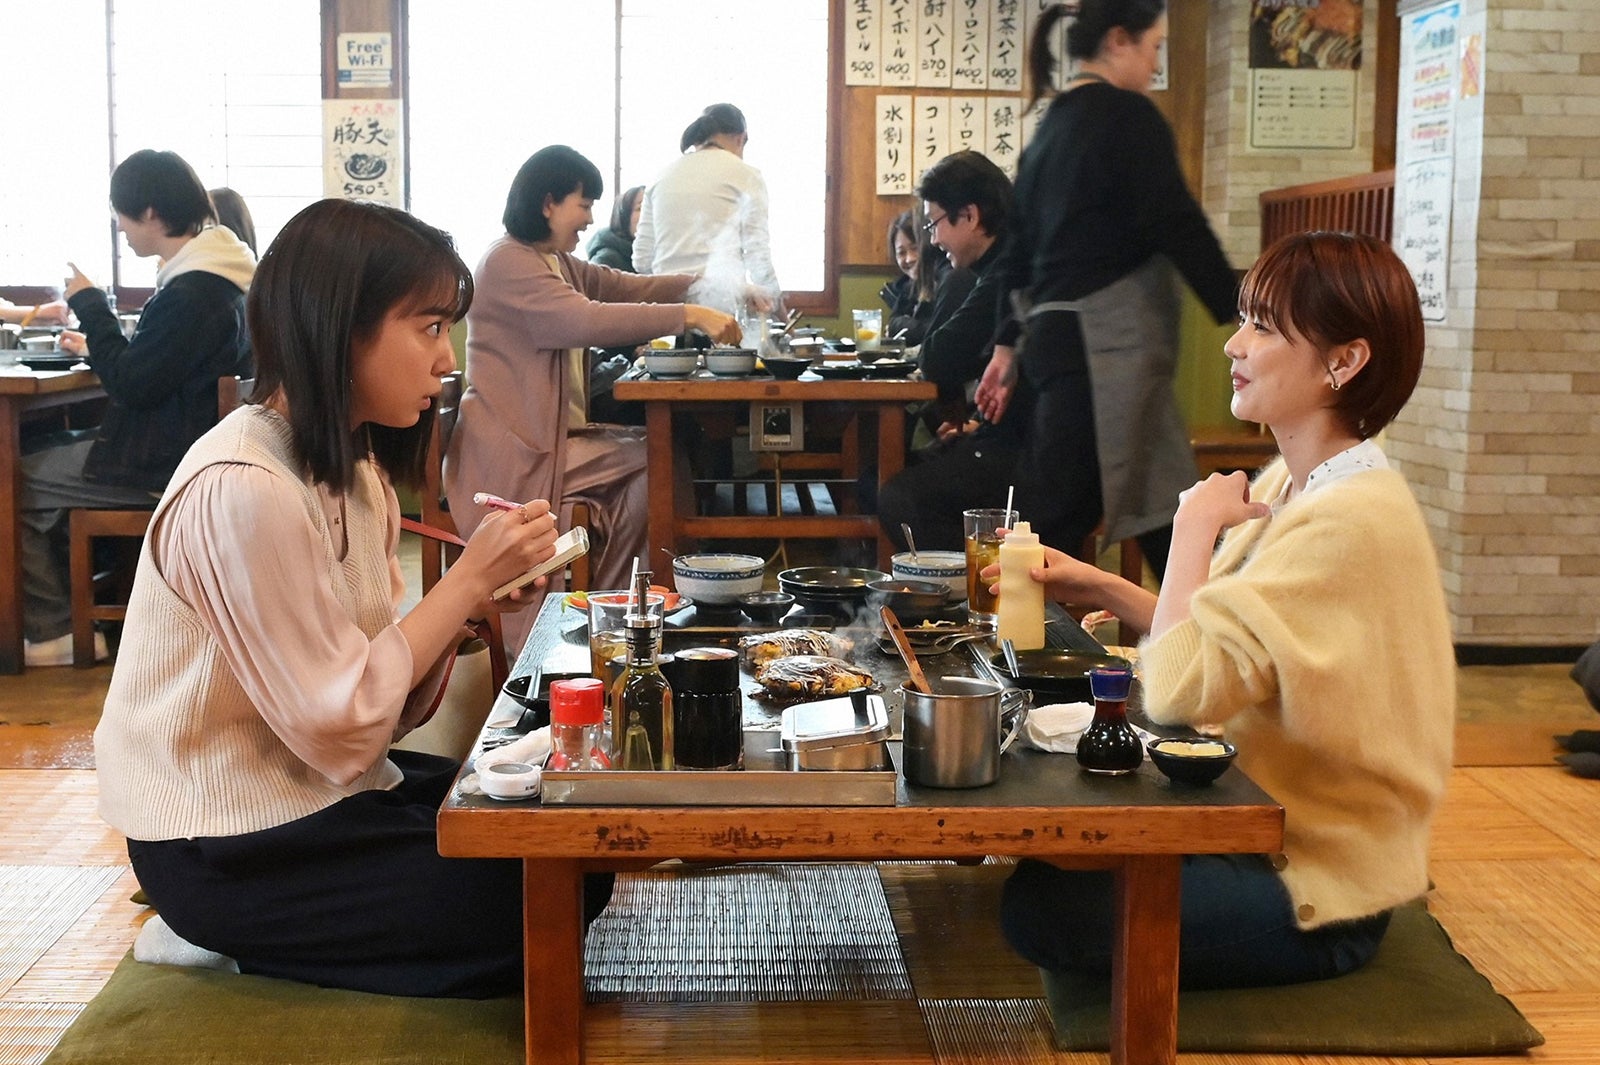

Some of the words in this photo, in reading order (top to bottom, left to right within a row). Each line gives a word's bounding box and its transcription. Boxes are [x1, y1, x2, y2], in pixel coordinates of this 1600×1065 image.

[347, 40, 382, 53] Free
[348, 55, 383, 66] Wi-Fi
[921, 59, 946, 70] 370
[851, 61, 874, 72] 500
[885, 63, 910, 74] 400
[955, 68, 981, 78] 400
[992, 68, 1017, 78] 400
[884, 104, 903, 168] 水割り
[925, 106, 938, 157] コーラ
[993, 106, 1014, 155] 緑茶
